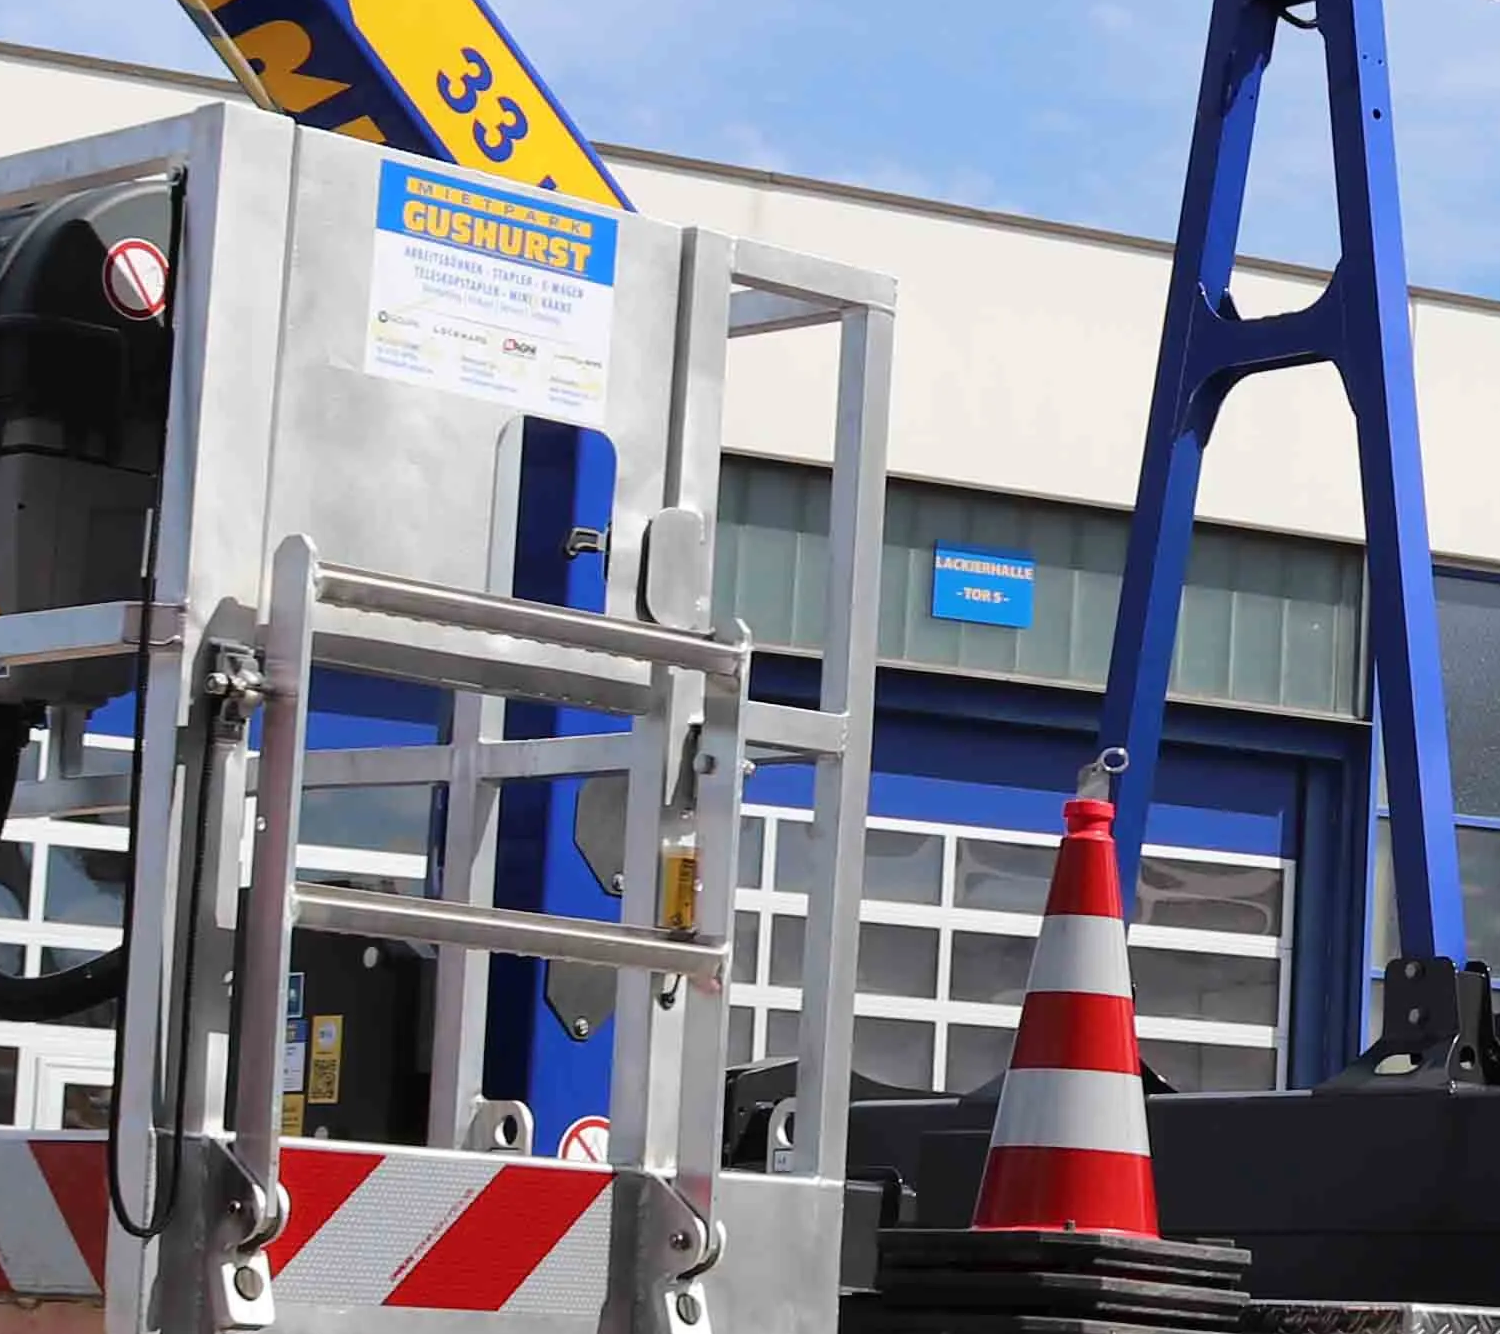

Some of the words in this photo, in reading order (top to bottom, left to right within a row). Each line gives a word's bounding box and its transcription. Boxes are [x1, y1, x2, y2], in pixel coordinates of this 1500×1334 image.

[436, 47, 529, 162] 33
[403, 199, 592, 274] GUSHURST
[419, 181, 581, 234] MIETPARK
